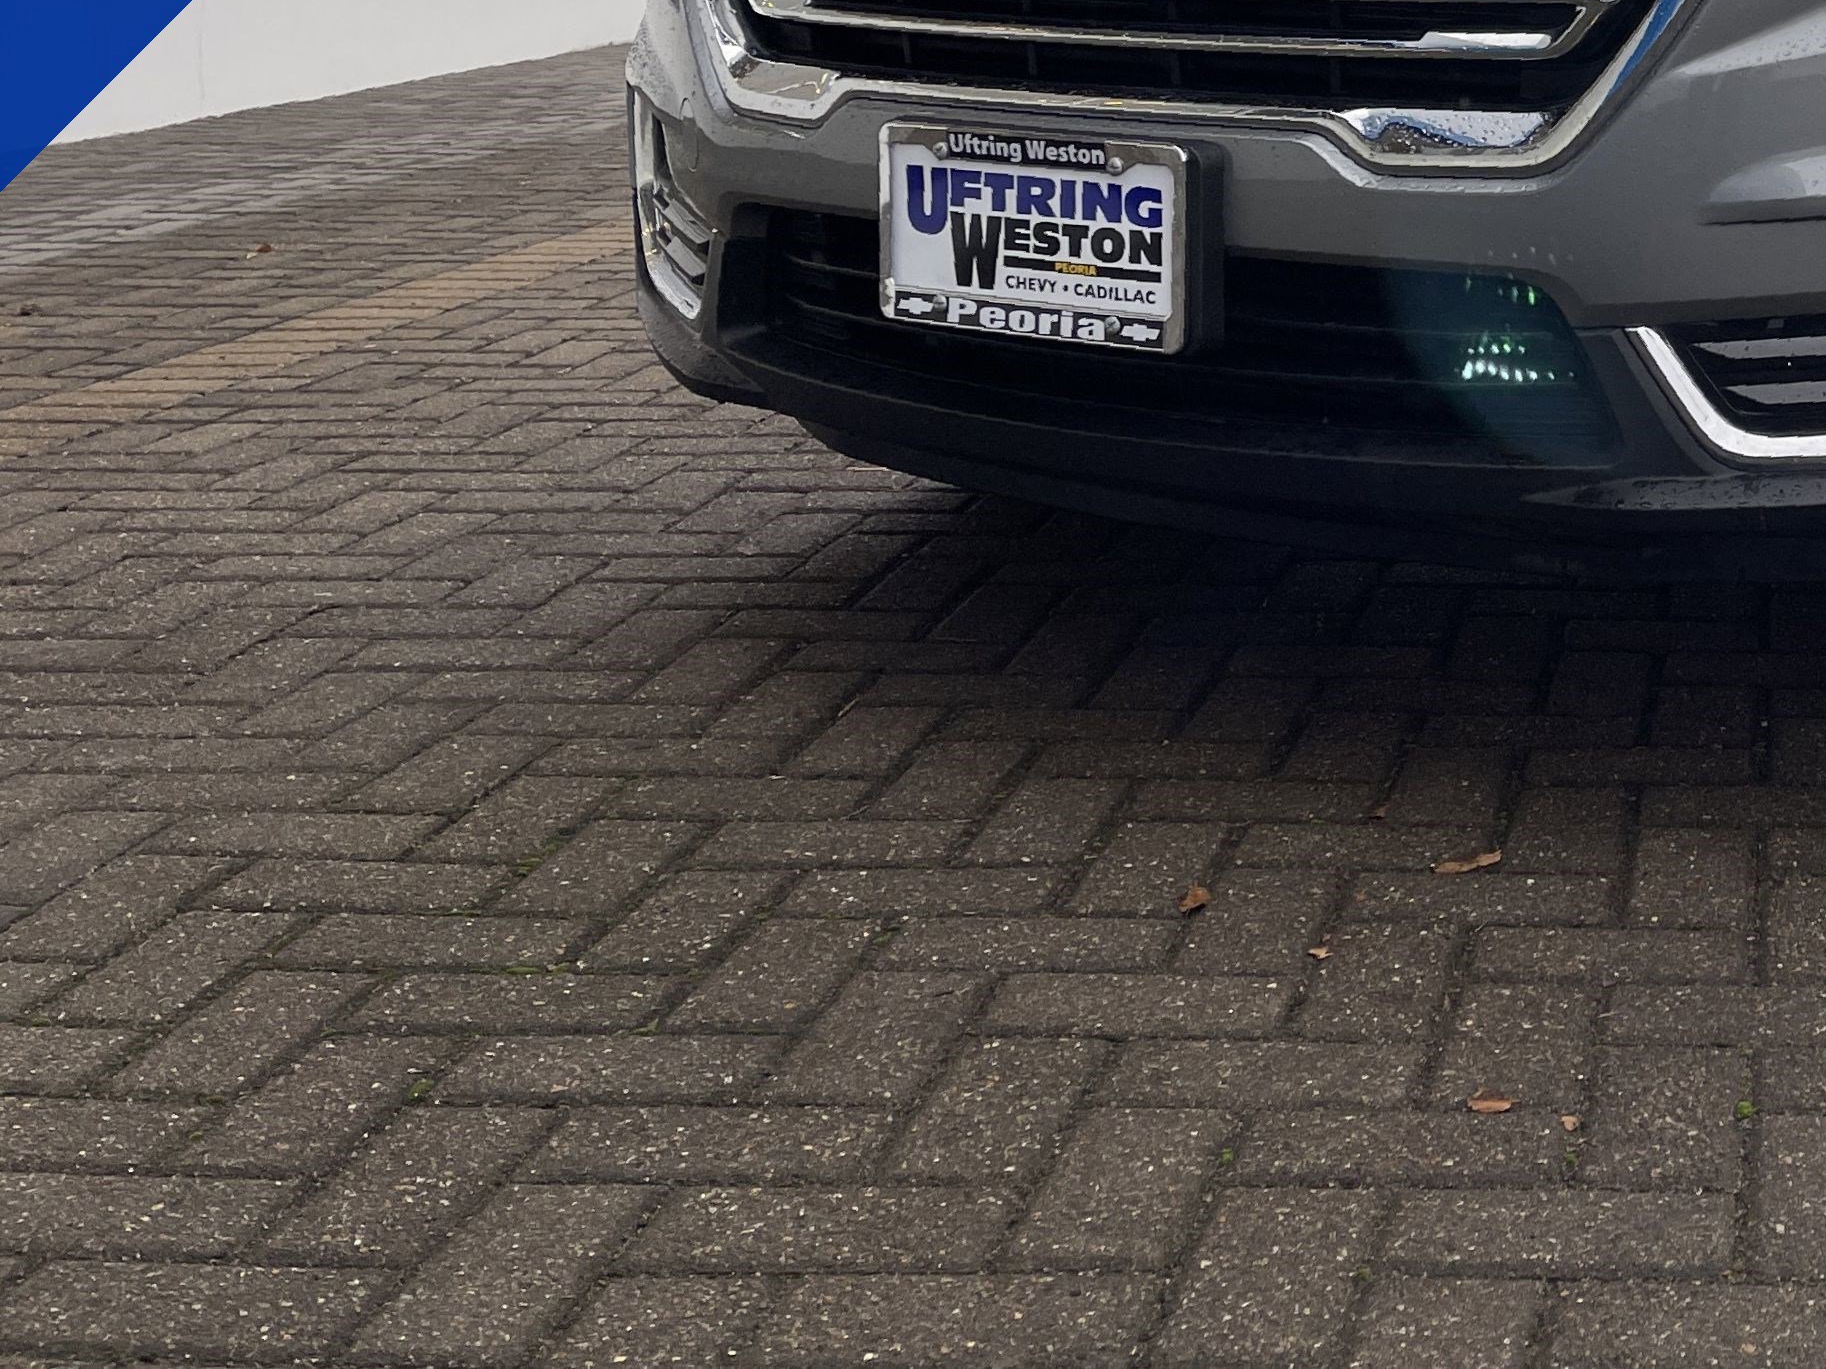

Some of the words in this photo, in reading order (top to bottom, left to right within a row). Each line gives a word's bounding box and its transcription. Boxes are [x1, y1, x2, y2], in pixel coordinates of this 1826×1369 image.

[950, 133, 1022, 163] Uftring
[1025, 140, 1105, 165] Weston
[906, 164, 1163, 235] UFTRING
[950, 211, 1163, 291] WESTON
[1054, 262, 1097, 276] PEORIA
[1005, 275, 1057, 293] CHEVY
[1074, 283, 1156, 304] CADILLAC
[947, 297, 1105, 341] Peoria
